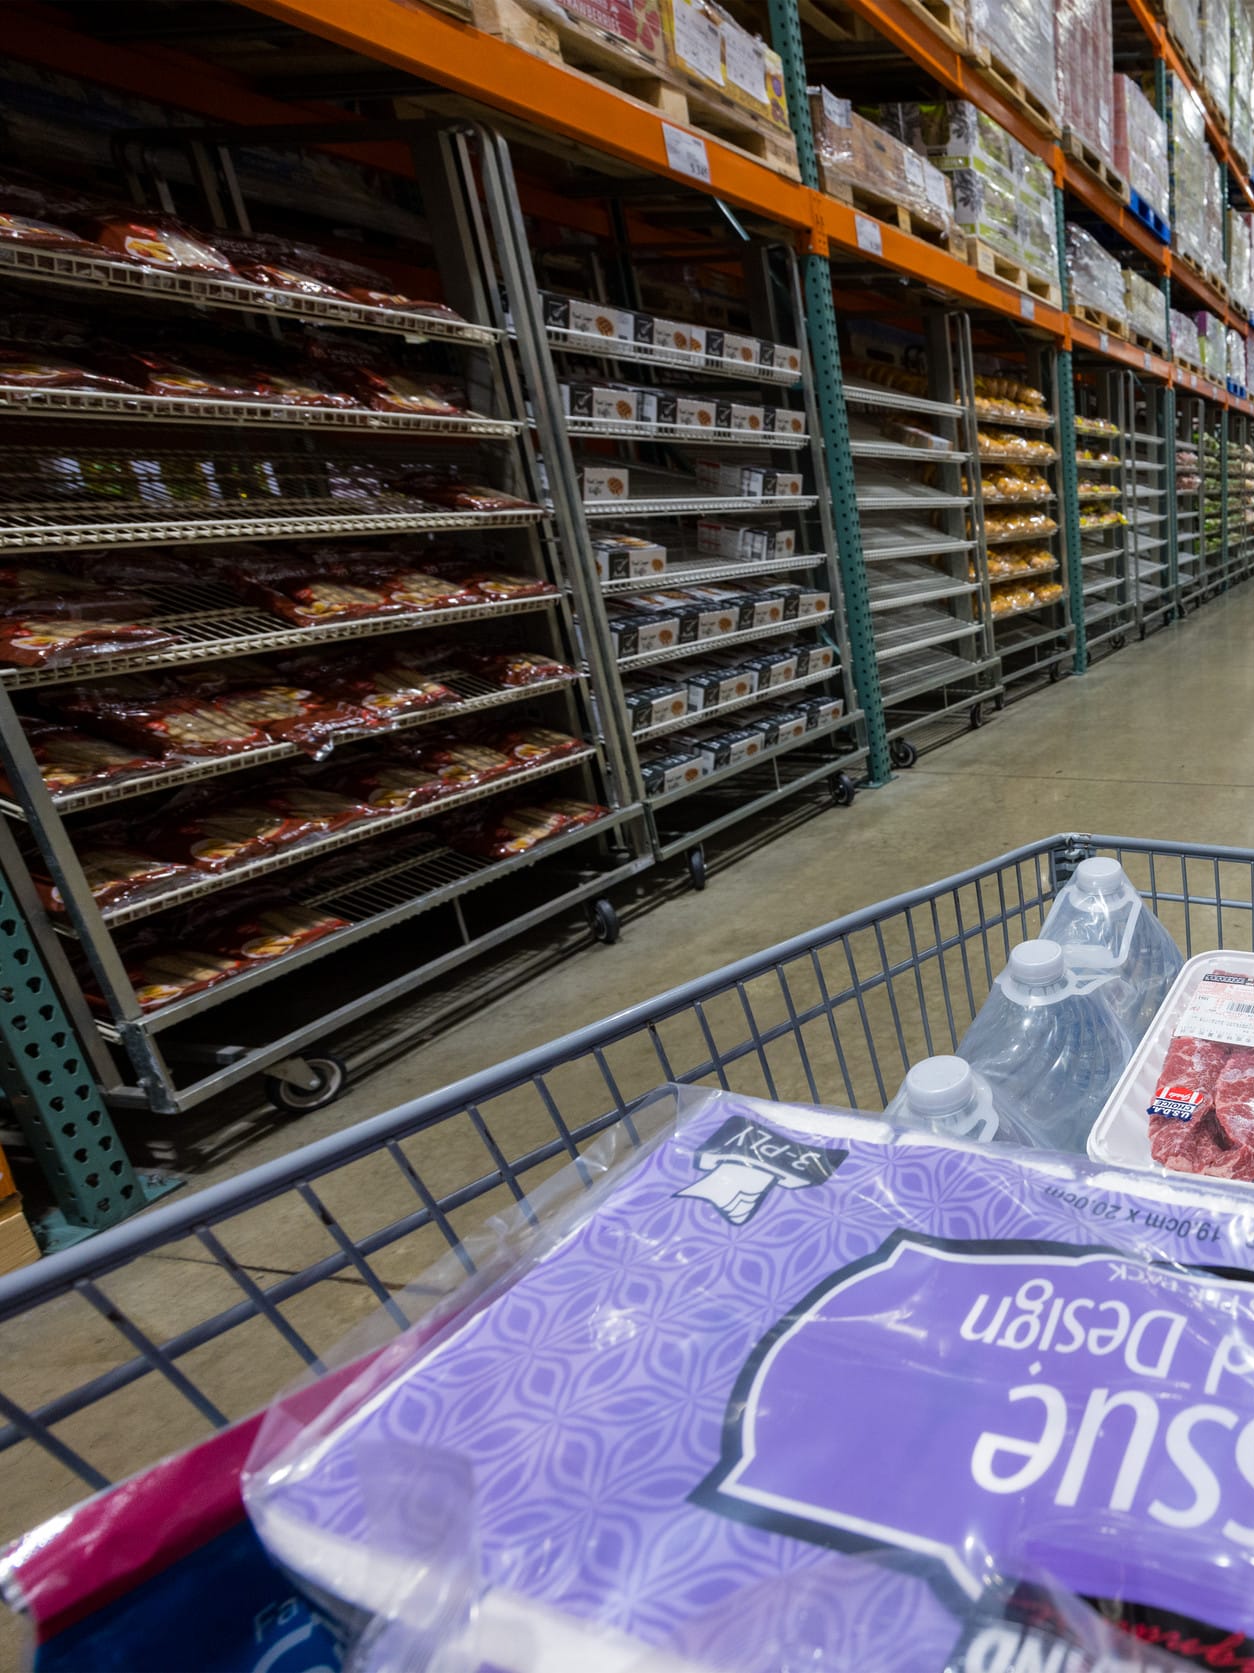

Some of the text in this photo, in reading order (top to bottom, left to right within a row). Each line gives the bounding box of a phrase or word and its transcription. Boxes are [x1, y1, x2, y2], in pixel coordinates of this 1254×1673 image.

[1152, 1105, 1190, 1119] U.S.D.A.
[1155, 1100, 1192, 1111] CHOICE
[724, 1126, 821, 1171] 3-PLY
[1042, 1184, 1121, 1220] 20.0cm
[1126, 1208, 1139, 1222] x
[1146, 1209, 1221, 1243] 19.0cm
[1107, 1262, 1179, 1291] PACK
[959, 1278, 1188, 1380] Design
